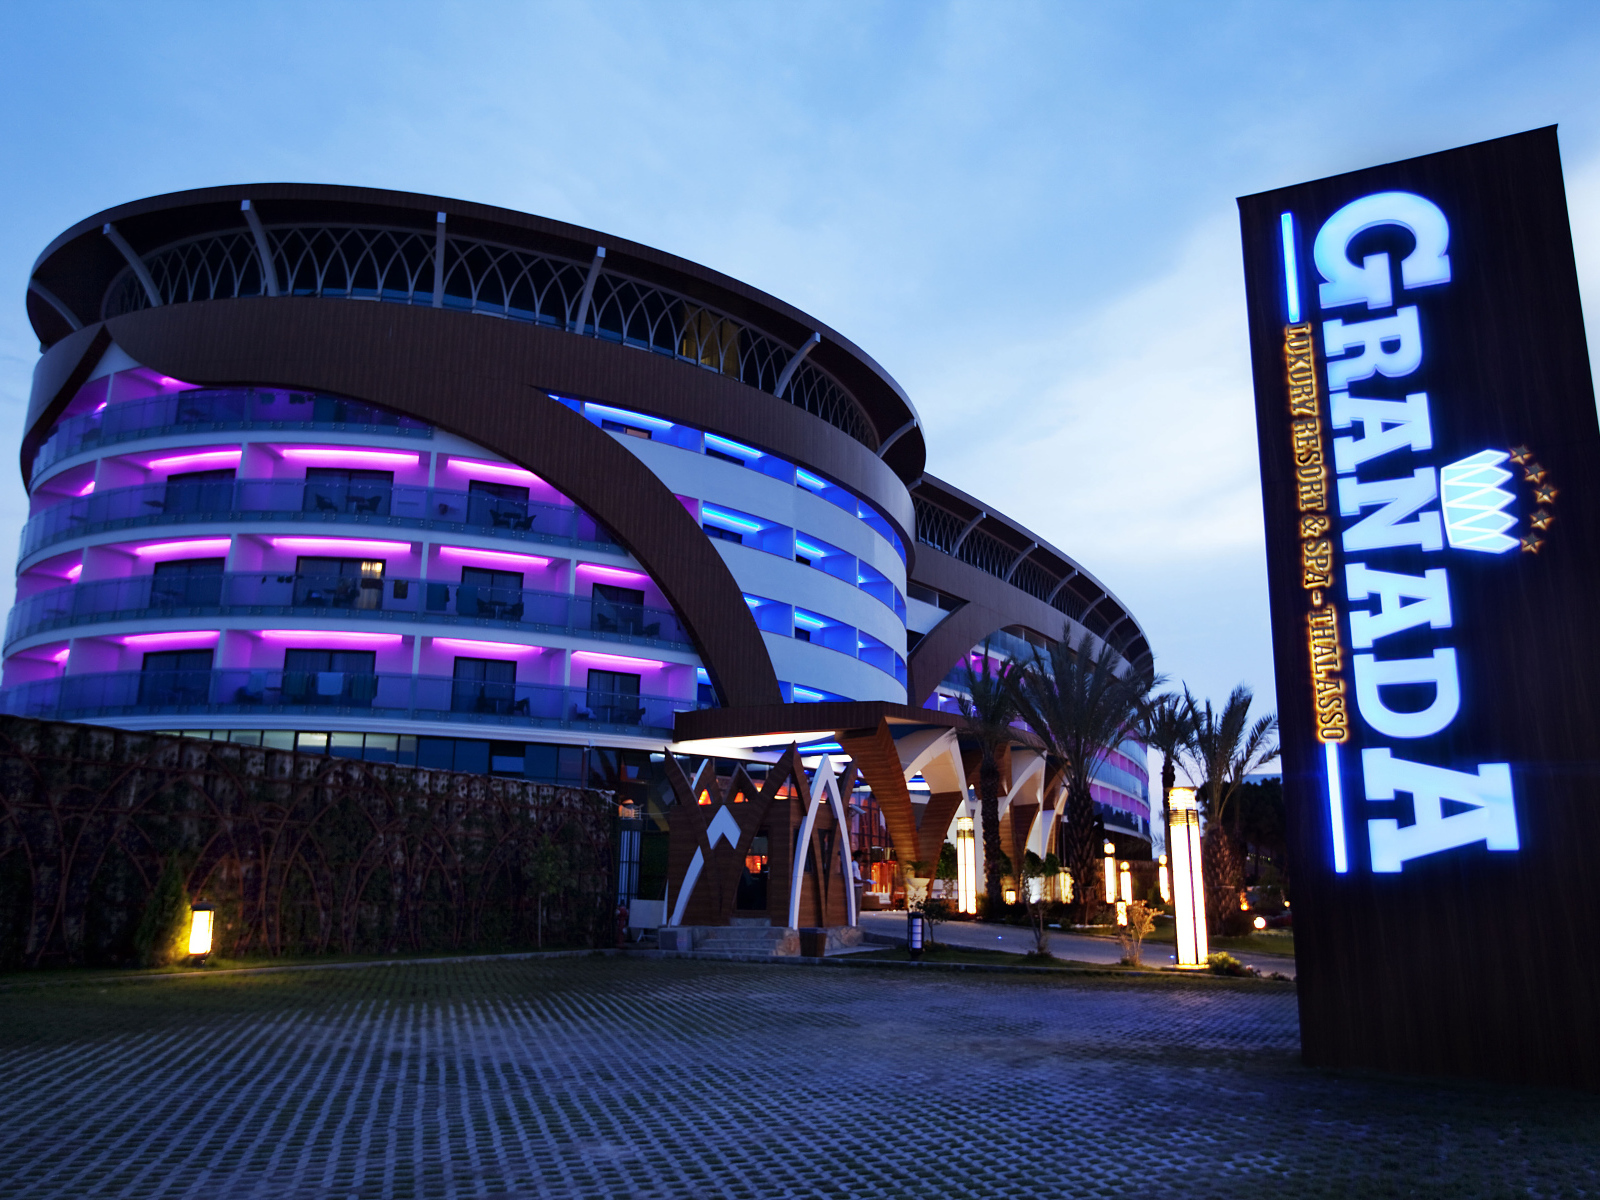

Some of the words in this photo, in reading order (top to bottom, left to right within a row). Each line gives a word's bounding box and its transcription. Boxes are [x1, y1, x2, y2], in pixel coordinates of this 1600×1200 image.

[1286, 321, 1317, 416] LUXURY
[1293, 418, 1326, 511] RESORT
[1301, 515, 1329, 537] &
[1304, 538, 1331, 588] SPA
[1314, 191, 1519, 874] GRANADA
[1310, 606, 1346, 741] THALASSO
